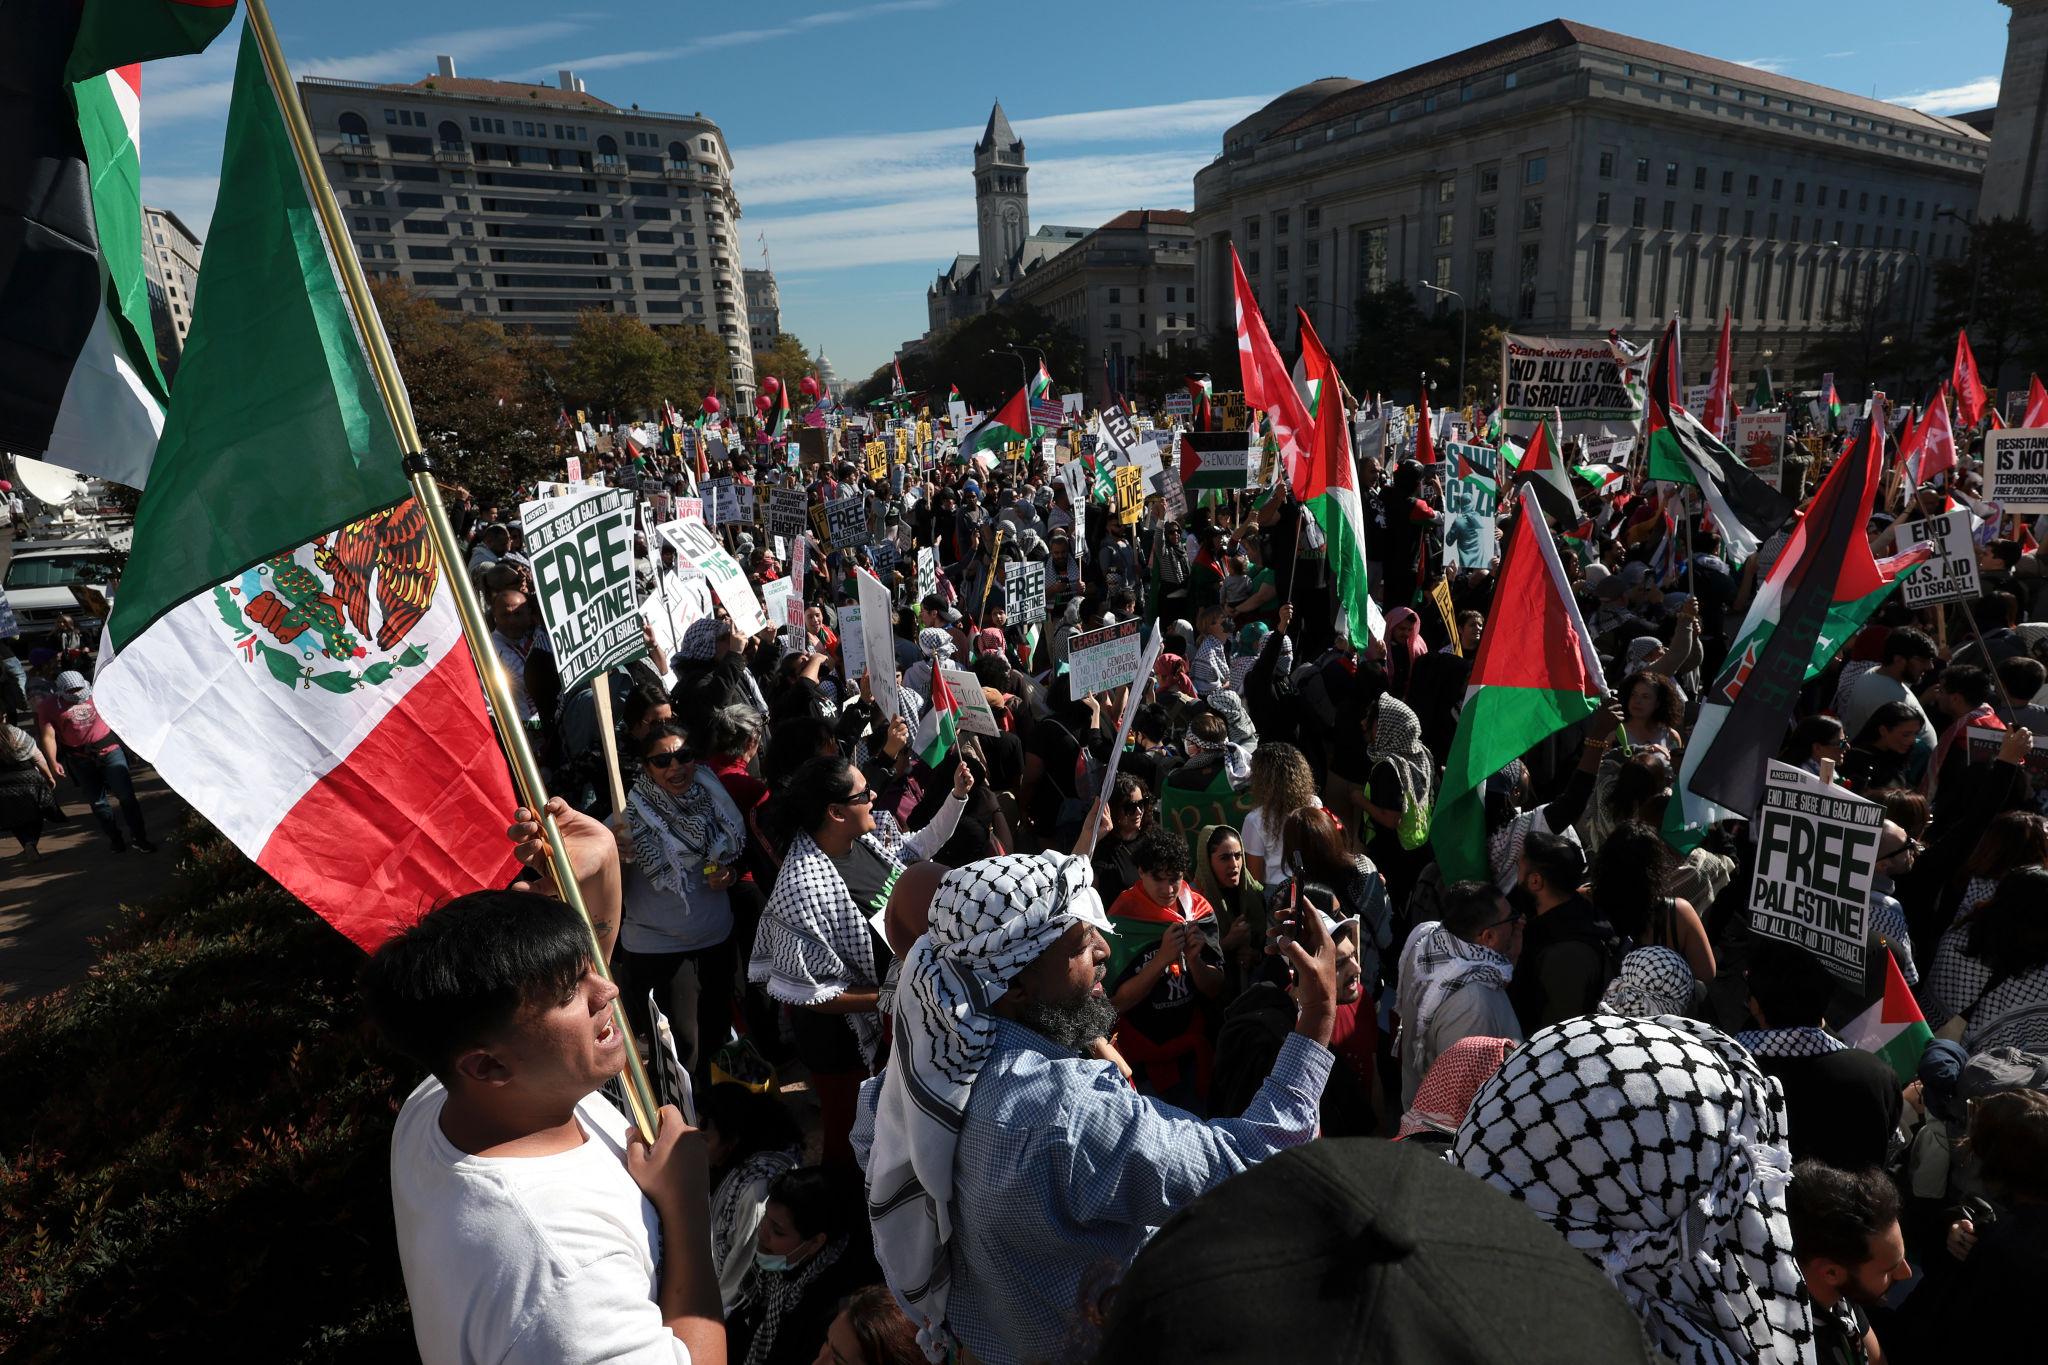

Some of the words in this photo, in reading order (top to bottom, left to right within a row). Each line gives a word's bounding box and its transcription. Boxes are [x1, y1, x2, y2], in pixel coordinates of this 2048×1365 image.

[1508, 344, 1544, 357] Stand
[1547, 348, 1571, 359] with
[1509, 359, 1537, 381] END
[1539, 361, 1565, 382] ALL
[1569, 361, 1592, 383] U.S.
[1211, 394, 1228, 407] END
[1506, 384, 1521, 405] OF
[1523, 384, 1578, 407] ISRAELI
[1227, 406, 1245, 418] WAR
[1747, 431, 1772, 441] GAZA
[1203, 453, 1245, 467] GENOCIDE
[1997, 451, 2014, 470] IS
[1119, 480, 1143, 511] LIVE
[1994, 487, 2012, 496] FREE
[525, 503, 547, 524] ANSWER
[529, 530, 542, 553] END
[542, 522, 555, 544] THE
[580, 499, 600, 521] GAZA
[600, 491, 620, 512] NOW!
[828, 505, 864, 533] FREE
[666, 522, 717, 559] END
[1911, 517, 1950, 542] END
[534, 513, 630, 629] FREE
[700, 551, 738, 584] THE
[1942, 559, 1971, 579] AID
[1007, 570, 1044, 604] FREE
[1907, 586, 1922, 599] TO
[552, 581, 634, 666] PALESTINE!
[1071, 627, 1117, 651] CEASEFIRE
[1120, 621, 1137, 637] NOW
[562, 664, 573, 688] END
[573, 656, 585, 678] ALL
[585, 647, 599, 667] U.S.
[605, 629, 615, 648] TO
[615, 616, 640, 642] ISRAEL
[1107, 651, 1136, 668] GENOCIDE
[1098, 672, 1134, 691] PALESTINE
[1101, 661, 1138, 680] OCCUPATION
[1771, 770, 1798, 782] ANSWER
[1767, 788, 1783, 806] END
[1785, 792, 1798, 809] THE
[1800, 795, 1819, 814] SIEGE
[1820, 799, 1831, 815] ON
[1833, 802, 1851, 820] GAZA
[1854, 806, 1882, 825] NOW!
[1757, 809, 1876, 904] FREE
[1753, 877, 1864, 941] PALESTINE!
[1752, 912, 1768, 931] END
[1769, 918, 1786, 937] ALL
[1789, 924, 1803, 943] U.S.
[1805, 930, 1817, 949] AID
[1821, 935, 1831, 953] TO
[1834, 940, 1862, 965] ISRAEL
